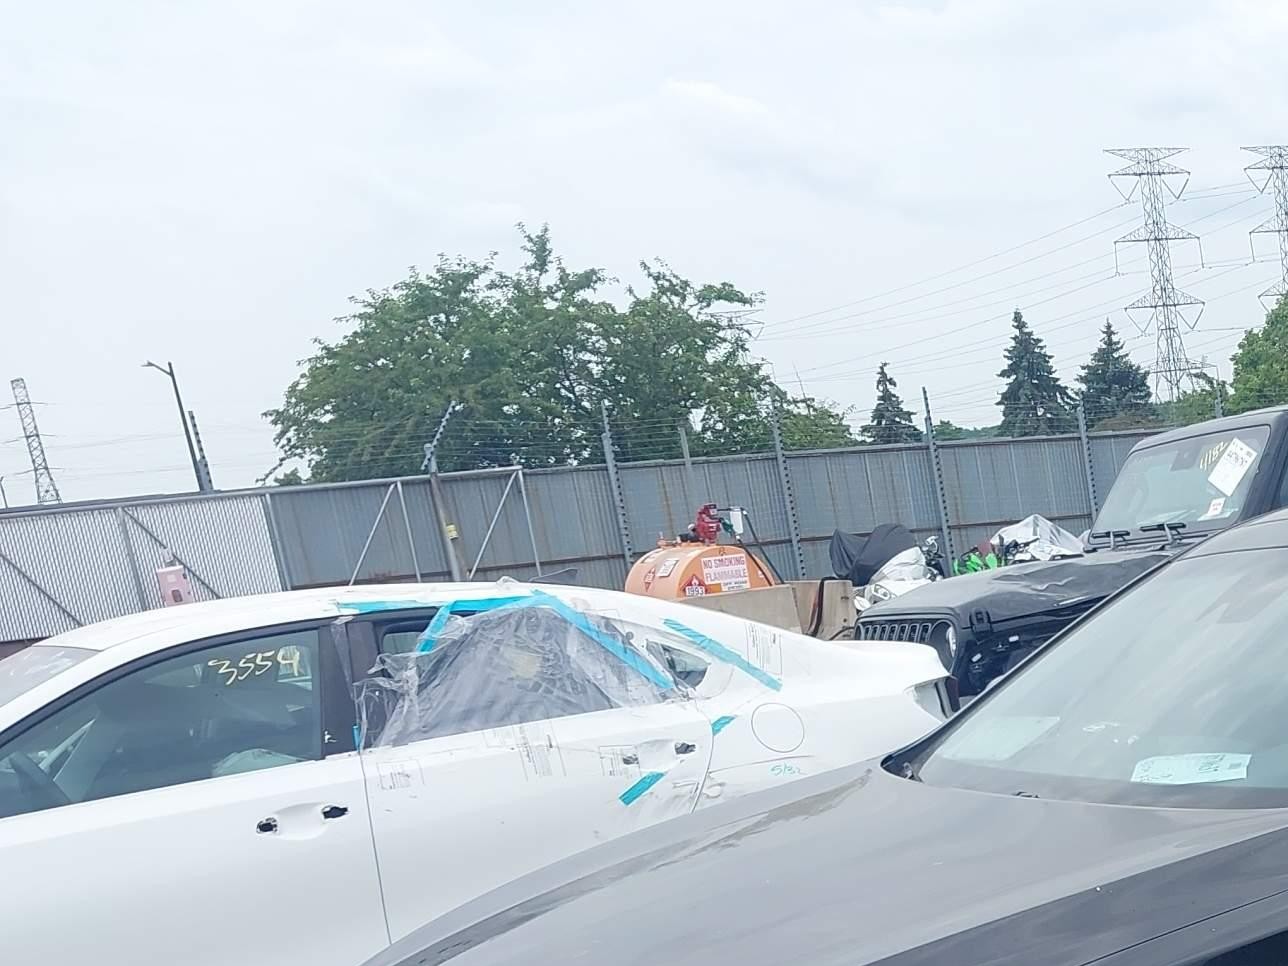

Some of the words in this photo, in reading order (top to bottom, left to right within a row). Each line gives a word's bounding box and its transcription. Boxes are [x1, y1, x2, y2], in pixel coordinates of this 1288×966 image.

[702, 559, 713, 570] NO
[713, 555, 746, 569] SMOKING
[705, 568, 748, 583] FLAMMABLE
[687, 586, 704, 595] 1993
